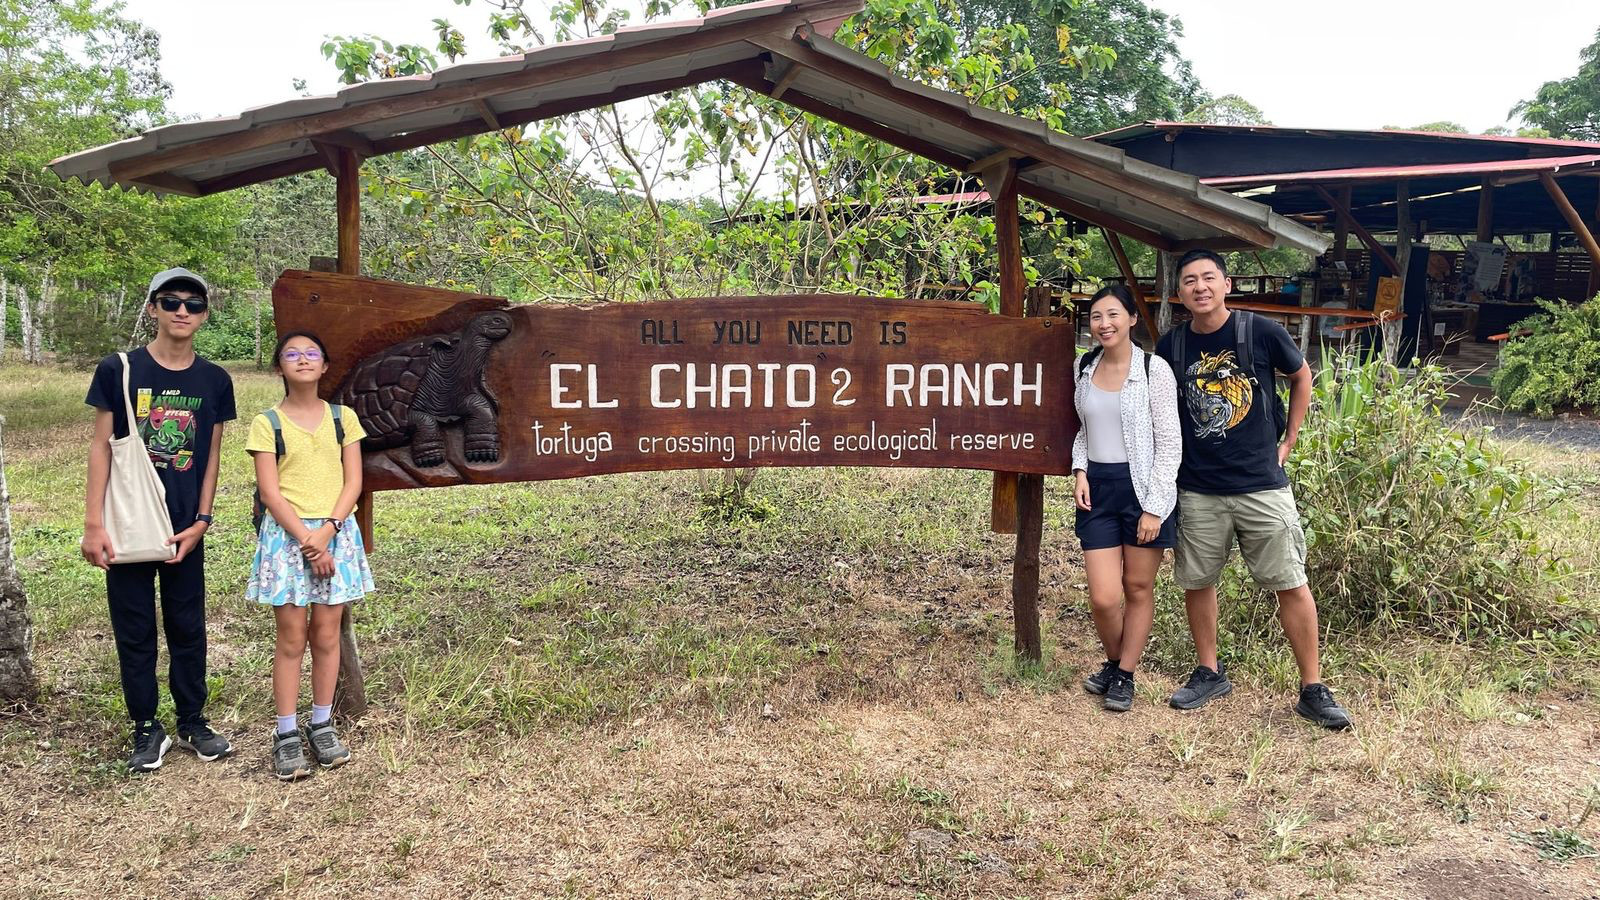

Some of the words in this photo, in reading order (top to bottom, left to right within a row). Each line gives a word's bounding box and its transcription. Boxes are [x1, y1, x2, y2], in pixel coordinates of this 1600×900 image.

[640, 319, 684, 345] ALL
[713, 319, 761, 345] YOU
[787, 320, 853, 346] NEED
[879, 321, 907, 345] IS
[830, 367, 857, 408] 2
[885, 362, 1043, 408] RANCH
[530, 420, 613, 462] tortuga
[638, 431, 735, 462] crossing
[748, 418, 821, 459] private
[833, 418, 938, 461] ecological
[950, 432, 1035, 451] reserve
